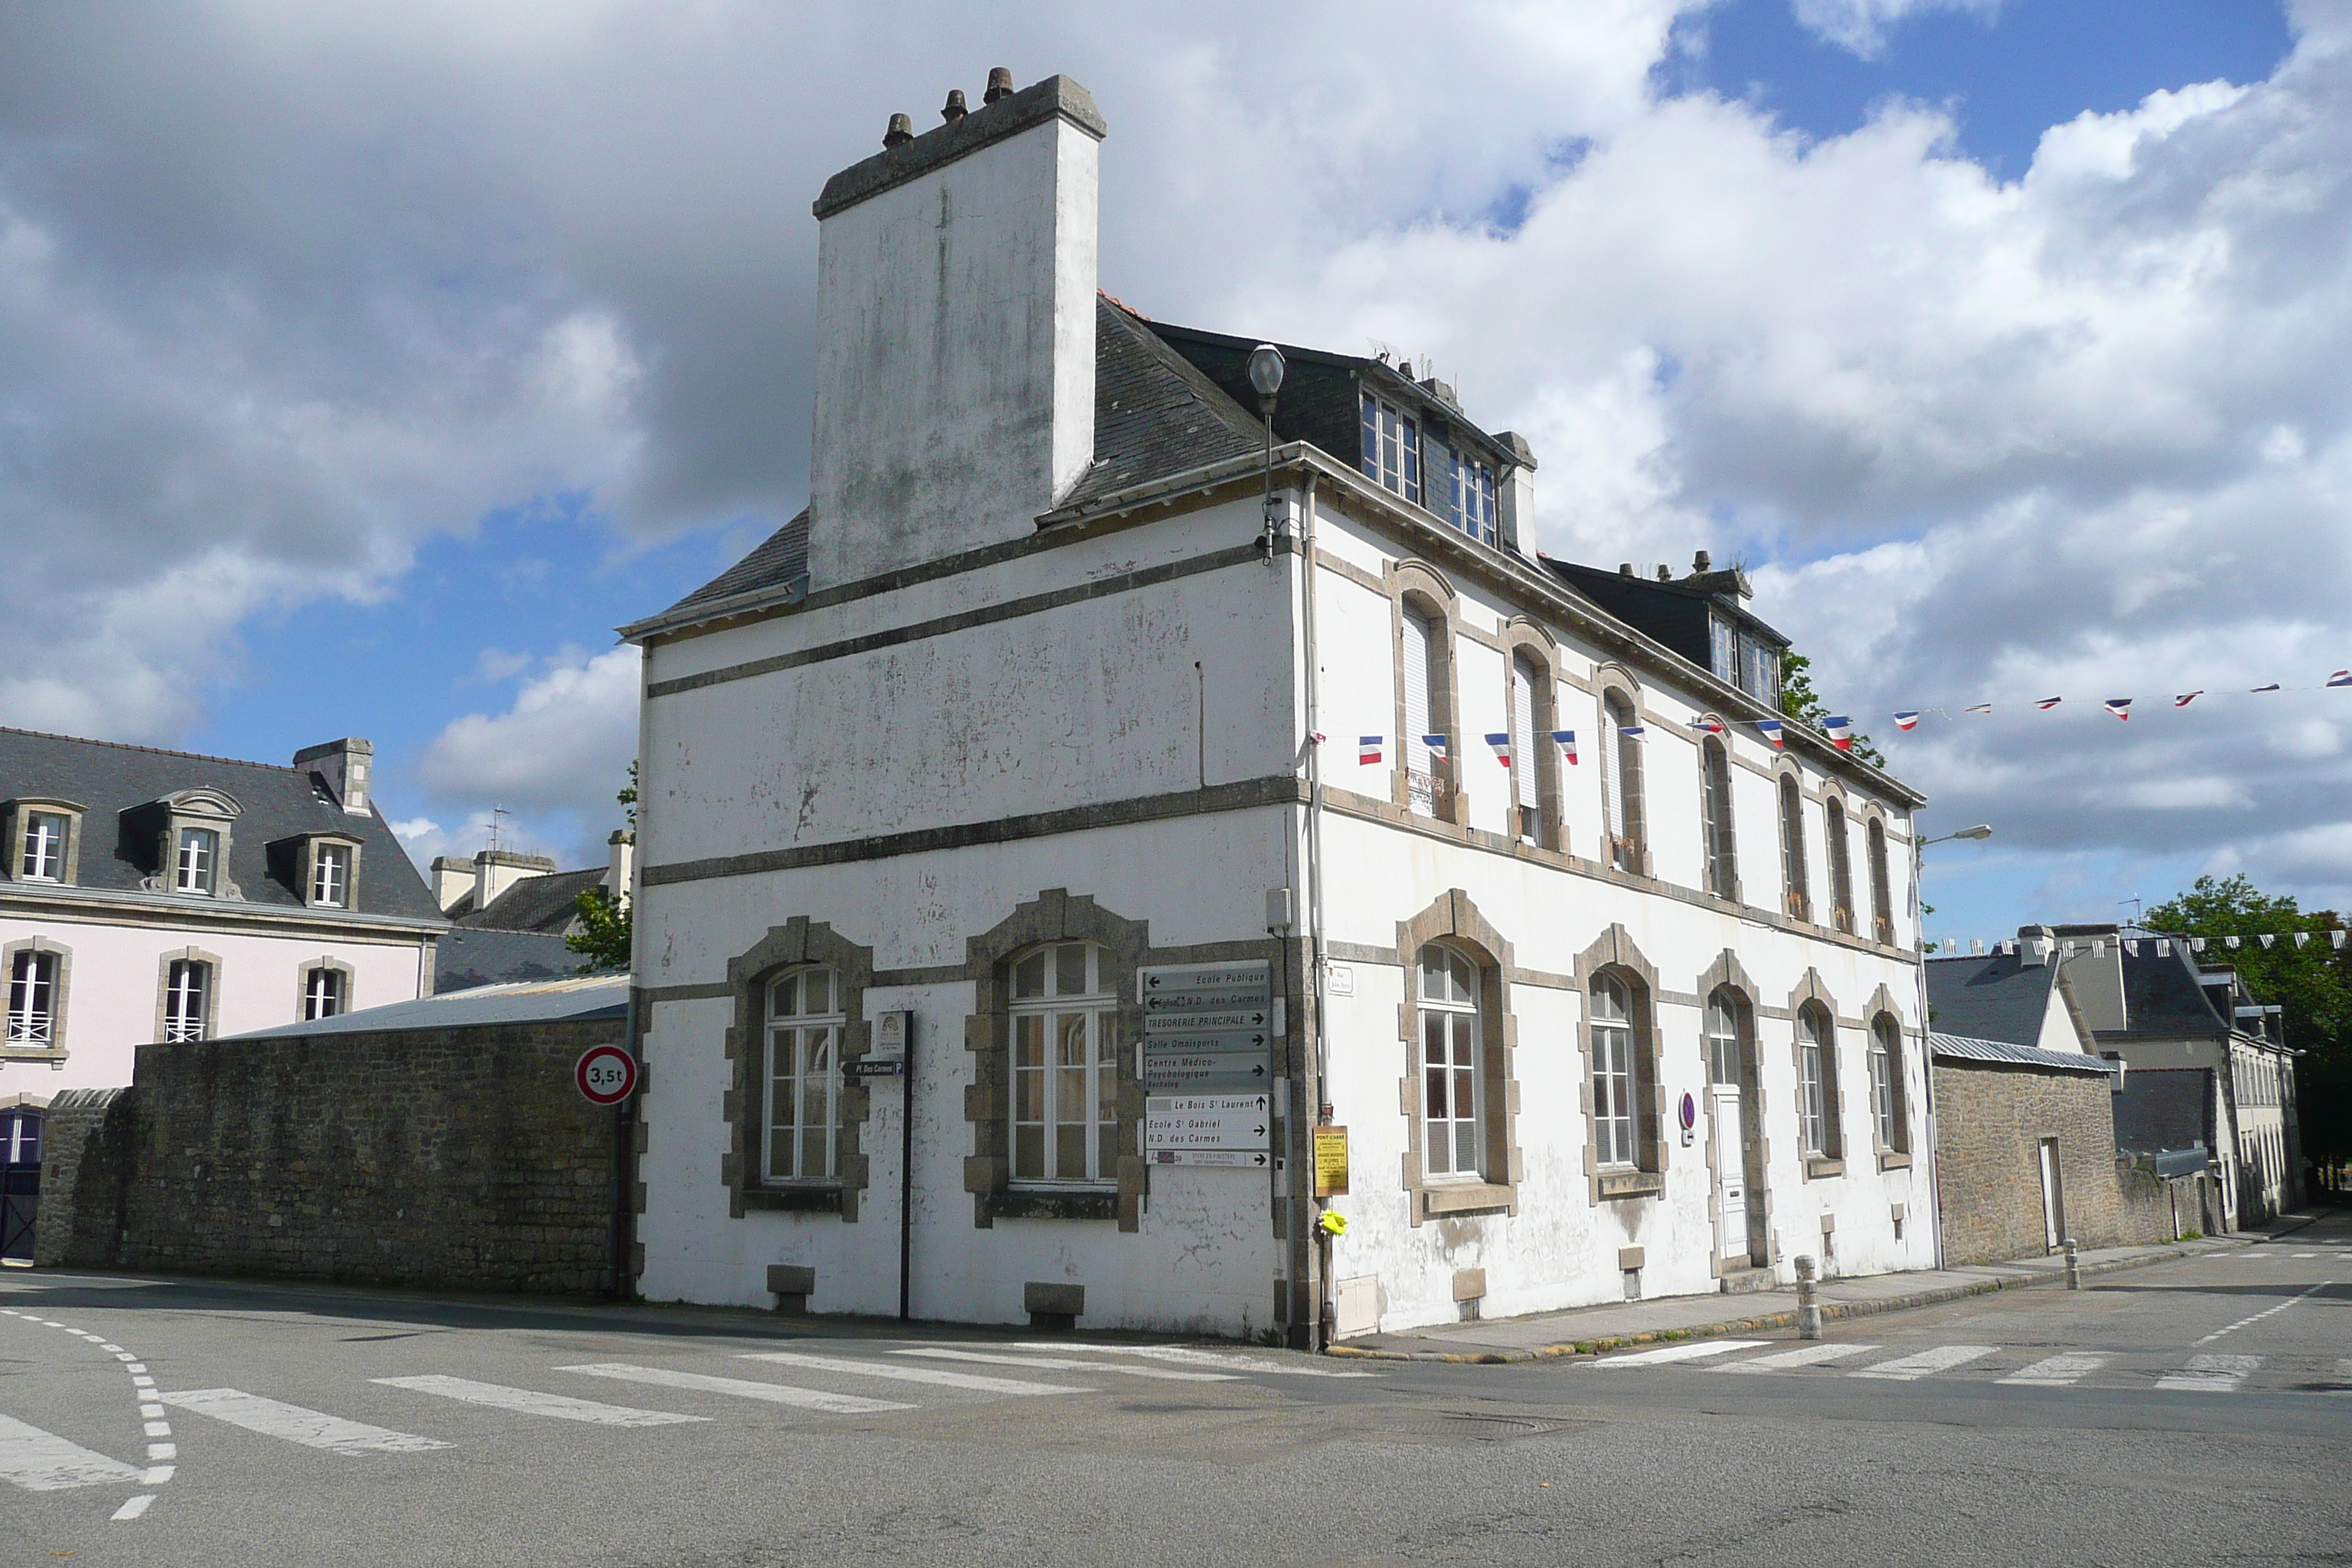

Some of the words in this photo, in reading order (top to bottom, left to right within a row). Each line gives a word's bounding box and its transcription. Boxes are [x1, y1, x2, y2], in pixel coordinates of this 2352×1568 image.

[1197, 975, 1220, 984] Ecole
[1226, 973, 1264, 983] Publique
[1210, 996, 1225, 1004] des
[1231, 995, 1264, 1003] Carmes
[1148, 1018, 1195, 1027] TRESORERIE
[1198, 1015, 1244, 1025] PRINCIPALE
[1148, 1040, 1167, 1049] Salle
[1172, 1039, 1219, 1049] Omnisports
[1148, 1059, 1176, 1067] Centre
[896, 1063, 902, 1074] P
[1148, 1069, 1210, 1079] Psychologique
[1175, 1101, 1184, 1109] Le
[1188, 1101, 1205, 1109] Bois
[1222, 1100, 1253, 1108] Laurent
[1149, 1120, 1171, 1128] Ecole
[1189, 1119, 1220, 1128] Gabriel
